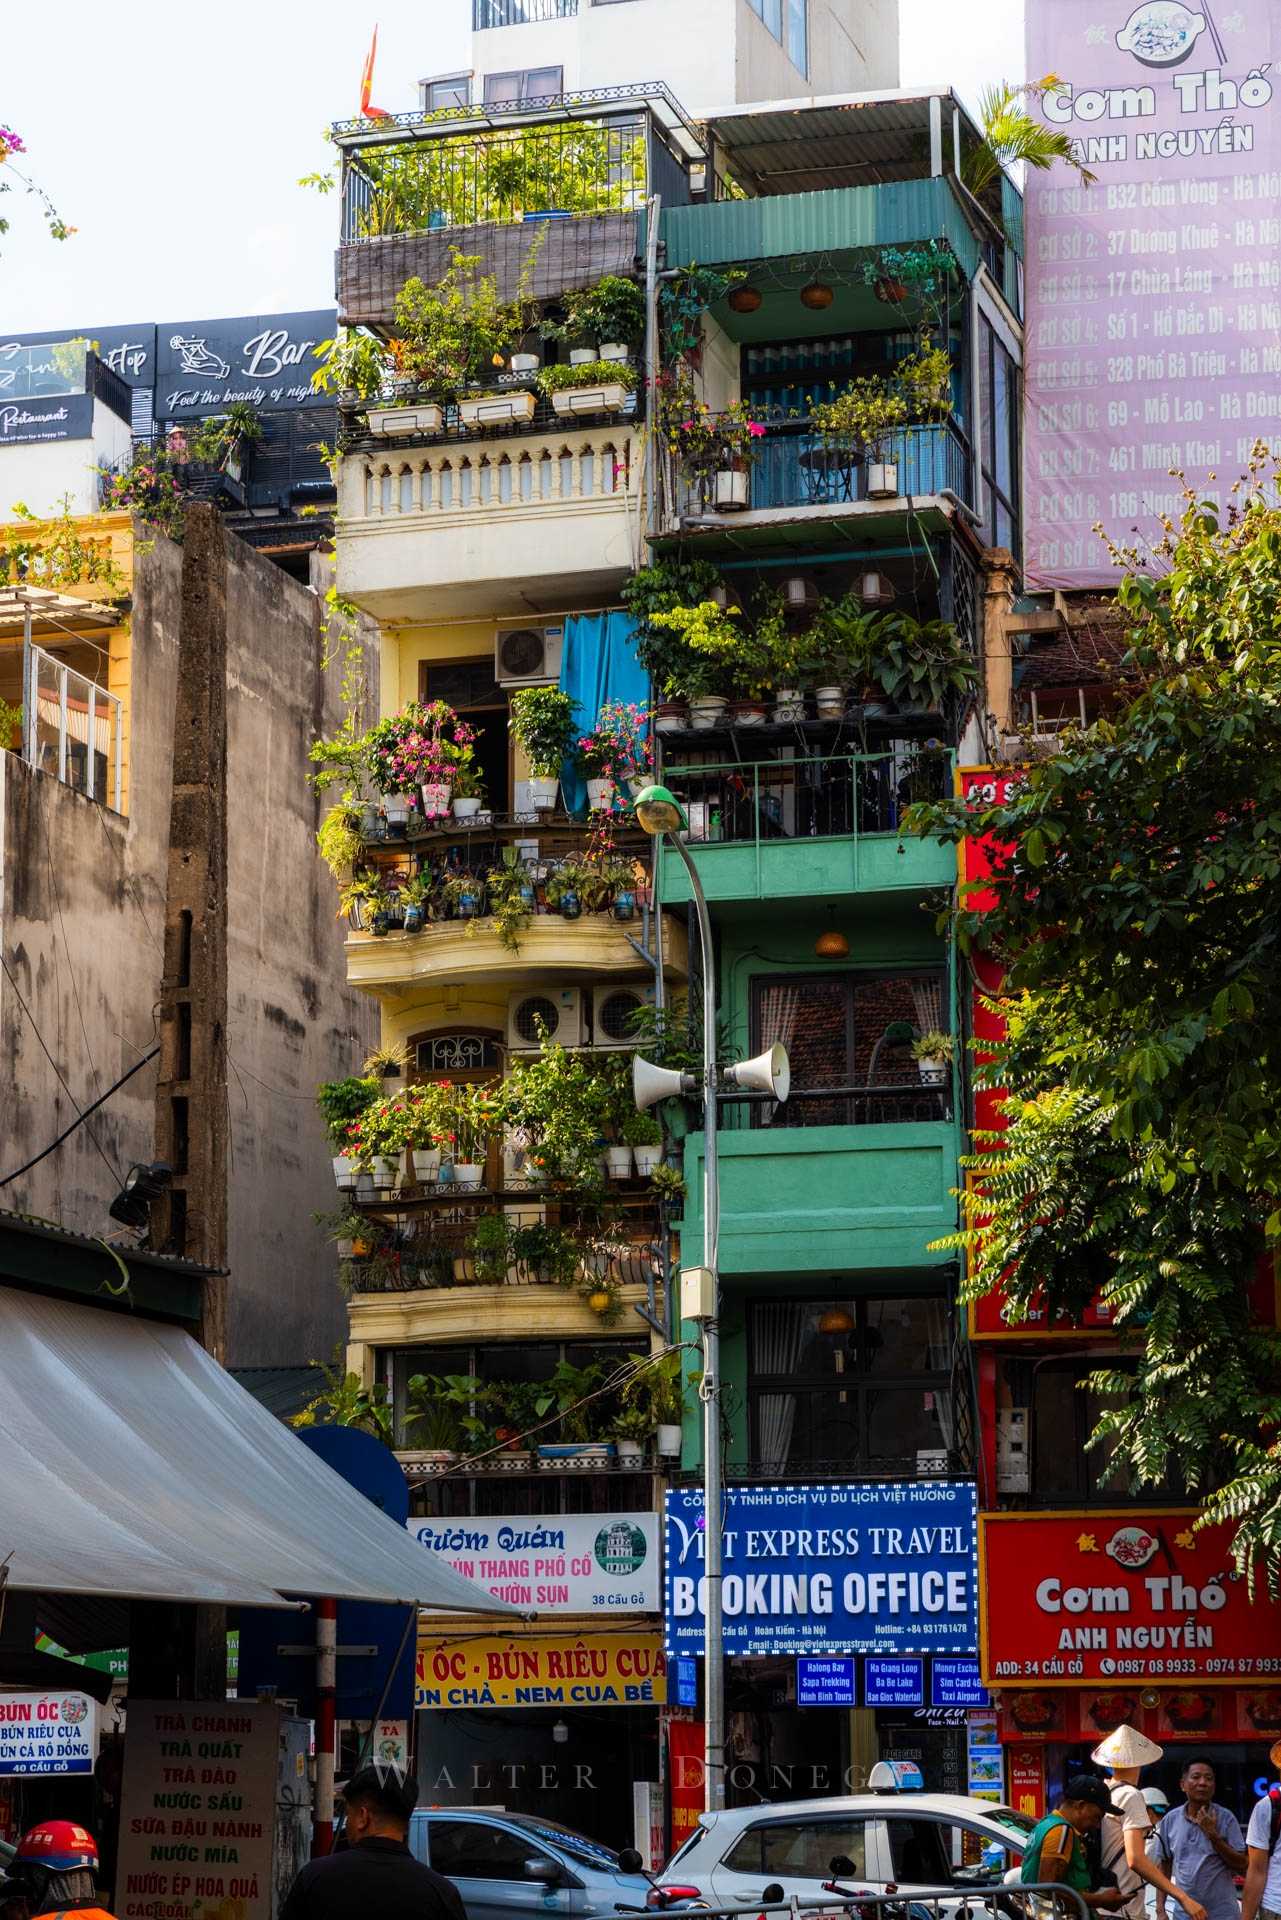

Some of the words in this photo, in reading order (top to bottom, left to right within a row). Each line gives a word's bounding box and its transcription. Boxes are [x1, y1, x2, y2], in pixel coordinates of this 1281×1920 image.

[1041, 83, 1156, 124] Cơm
[1173, 63, 1273, 113] Thố
[1136, 115, 1254, 160] NGUYỄN
[1107, 184, 1137, 211] B32
[1180, 179, 1218, 206] Vòng
[1233, 175, 1253, 201] Hà
[1107, 230, 1126, 256] 37
[1130, 228, 1177, 254] Dương
[1181, 223, 1219, 250] Khuê
[1235, 220, 1255, 247] Hà
[1107, 271, 1126, 297] 17
[1131, 267, 1170, 296] Chùa
[1175, 266, 1212, 295] Láng
[1233, 261, 1253, 288] Hà
[1107, 308, 1126, 340] Số
[1129, 313, 1138, 338] 1
[1237, 304, 1257, 331] Hà
[241, 329, 315, 378] Bar
[1107, 357, 1133, 384] 328
[1137, 348, 1164, 381] Phố
[1190, 349, 1226, 382] Triệu
[1240, 347, 1257, 374] Hà
[167, 390, 199, 413] Feel
[200, 389, 220, 406] the
[223, 386, 266, 406] beauty
[271, 387, 282, 402] of
[1107, 400, 1128, 427] 69
[1174, 396, 1204, 423] Lao
[1220, 392, 1241, 419] Hà
[1109, 446, 1136, 473] 461
[1186, 440, 1220, 467] Khai
[1109, 491, 1137, 519] 186
[741, 1495, 772, 1506] TNHH
[776, 1494, 806, 1507] DỊCH
[811, 1493, 827, 1506] VỤ
[831, 1493, 847, 1503] DU
[851, 1492, 878, 1504] LỊCH
[883, 1490, 906, 1504] VIỆT
[910, 1490, 956, 1501] HƯƠNG
[498, 1525, 564, 1552] Quán
[745, 1528, 859, 1558] EXPRESS
[868, 1527, 969, 1556] TRAVEL
[480, 1559, 529, 1578] THANG
[535, 1553, 565, 1577] PHỐ
[537, 1585, 568, 1607] SỤN
[592, 1595, 605, 1605] 38
[843, 1570, 967, 1613] OFFICE
[1036, 1577, 1130, 1613] Cơm
[1145, 1572, 1227, 1611] Thố
[1058, 1627, 1108, 1650] ANH
[1116, 1616, 1213, 1648] NGUYỄN
[433, 1641, 466, 1681] ỐC
[486, 1644, 539, 1681] BÚN
[546, 1641, 608, 1679] RIÊU
[616, 1649, 667, 1677] CUA
[832, 1662, 845, 1673] Bay
[901, 1663, 918, 1674] Loop
[934, 1663, 956, 1674] Money
[995, 1660, 1022, 1675] ADD:
[1024, 1661, 1040, 1675] 34
[1117, 1659, 1146, 1674] 0987
[1149, 1659, 1164, 1673] 08
[1166, 1658, 1196, 1673] 9933
[1206, 1658, 1236, 1673] 0974
[1238, 1658, 1253, 1672] 87
[448, 1682, 496, 1705] CHẢ
[516, 1687, 561, 1703] NEM
[571, 1685, 619, 1701] CUA
[803, 1677, 819, 1688] Sapa
[821, 1677, 850, 1688] Trekking
[940, 1677, 954, 1688] Sim
[955, 1678, 971, 1687] Card
[835, 1691, 852, 1701] Tours
[941, 1691, 956, 1701] Taxi
[956, 1691, 981, 1703] Airport
[37, 1696, 59, 1721] ỐC
[1, 1724, 24, 1740] BÚN
[27, 1723, 55, 1739] RIÊU
[58, 1726, 81, 1738] CUA
[154, 1713, 187, 1732] TRÀ
[192, 1716, 251, 1733] CHANH
[19, 1743, 35, 1758] CÁ
[38, 1741, 53, 1757] RÔ
[160, 1740, 192, 1759] TRÀ
[13, 1764, 27, 1773] 40
[163, 1766, 195, 1784] TRÀ
[202, 1766, 236, 1785] ĐÀO
[153, 1790, 200, 1810] NƯỚC
[208, 1790, 242, 1811] SẤU
[172, 1819, 207, 1840] ĐẬU
[212, 1818, 262, 1838] NÀNH
[150, 1844, 199, 1863] NƯỚC
[205, 1845, 238, 1863] MÍA
[127, 1872, 167, 1895] NƯỚC
[195, 1877, 224, 1898] HOA
[229, 1872, 258, 1899] QUẢ
